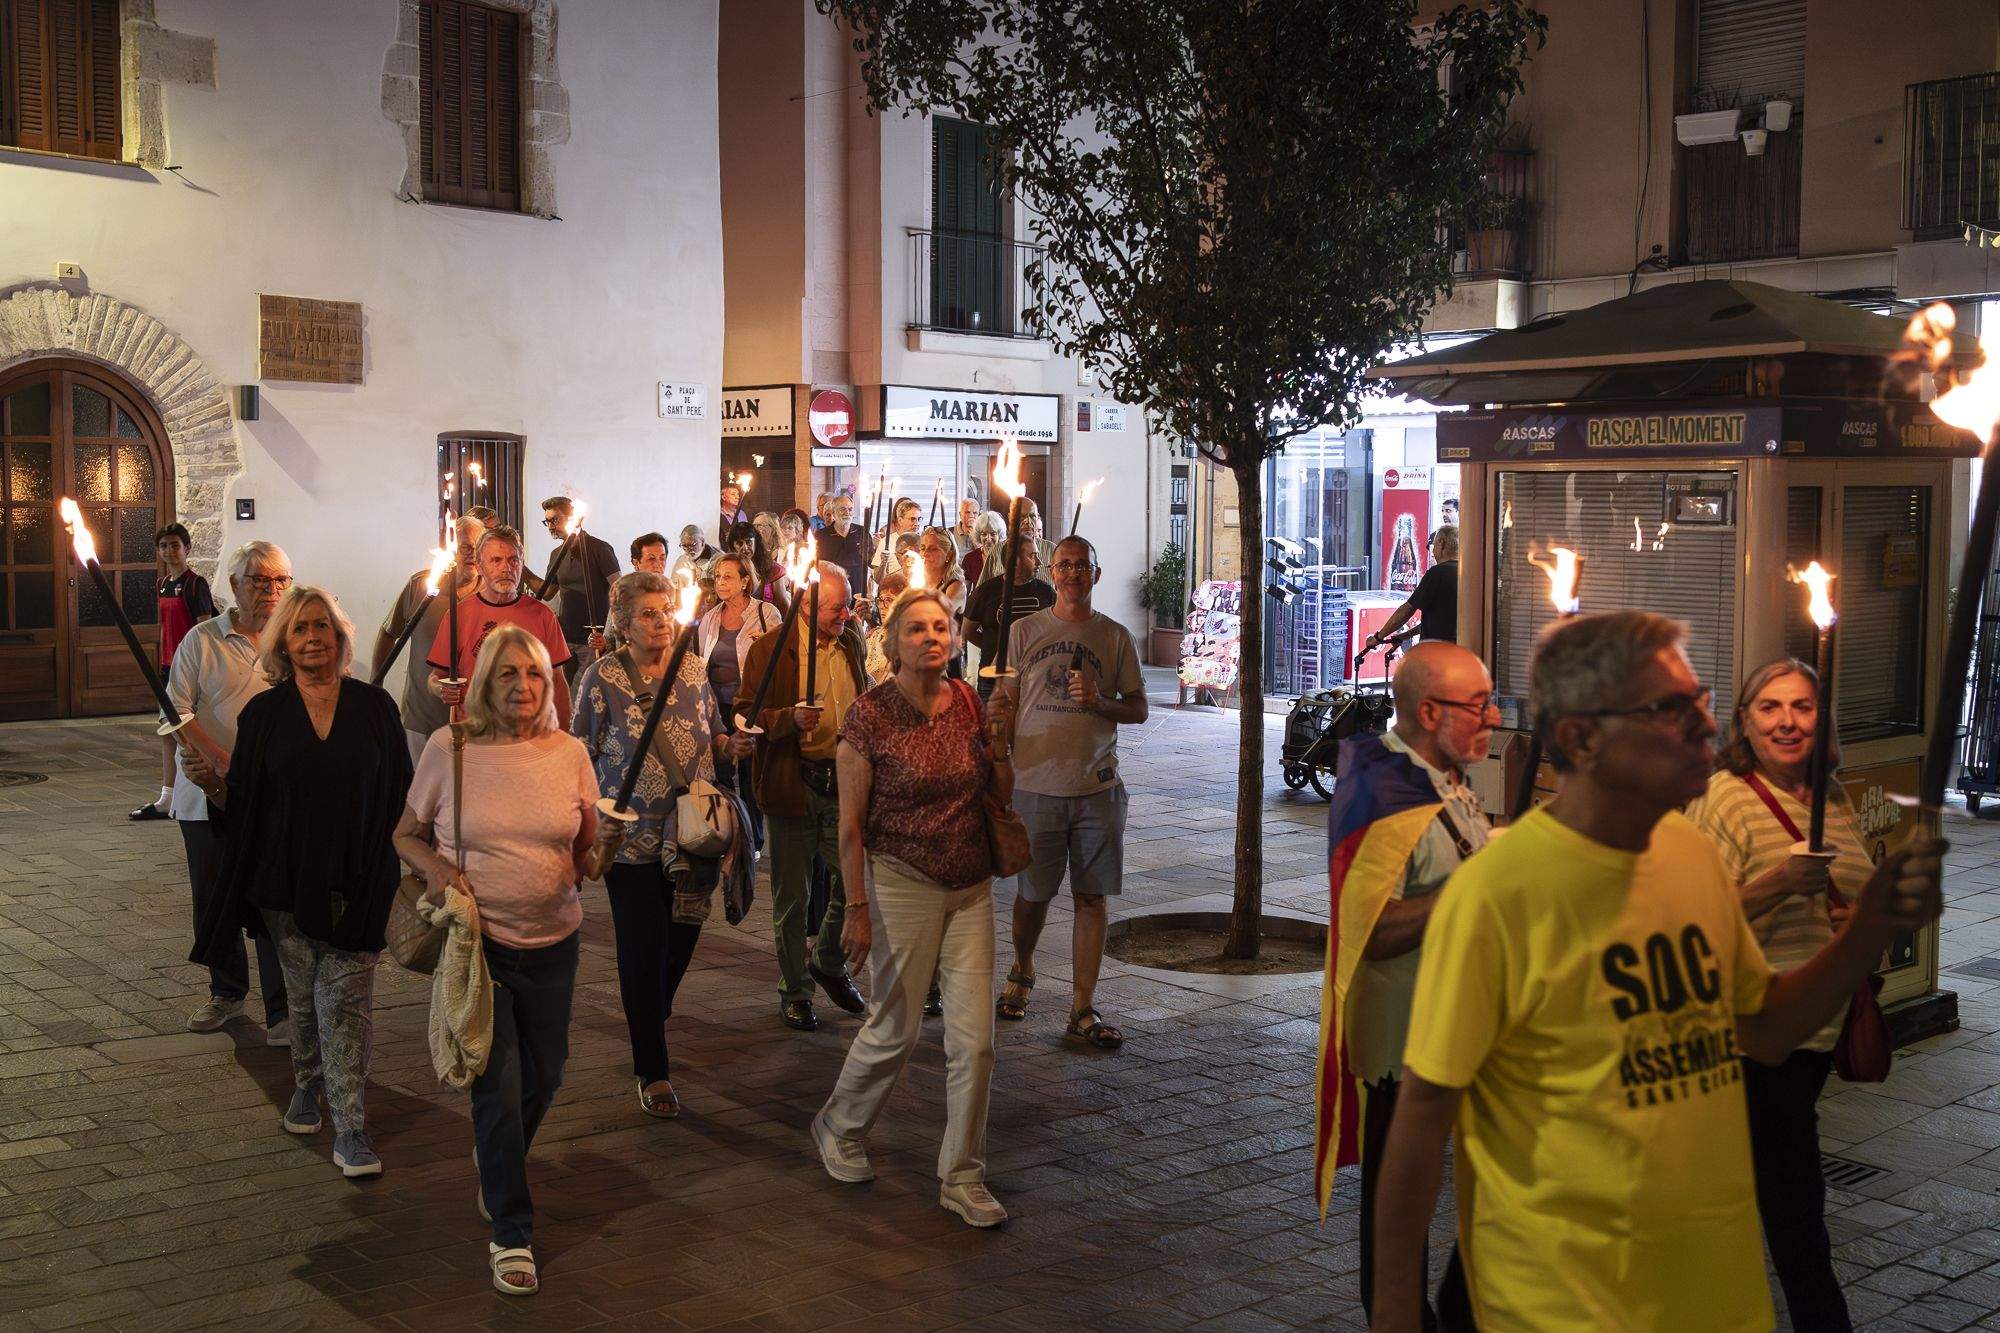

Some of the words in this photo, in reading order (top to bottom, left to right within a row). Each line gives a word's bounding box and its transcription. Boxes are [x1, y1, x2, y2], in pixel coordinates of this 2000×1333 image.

[66, 267, 73, 275] 4
[679, 387, 695, 395] PLAÇA
[684, 396, 691, 404] DE
[667, 405, 684, 415] SANT
[686, 406, 702, 416] PERE
[721, 398, 760, 420] IAN
[930, 398, 1019, 424] MARIAN
[1018, 429, 1037, 437] desde
[1037, 430, 1053, 438] 1956
[1503, 426, 1556, 441] RASCAS
[1589, 418, 1644, 446] RASCA
[1646, 417, 1667, 444] EL
[1668, 415, 1745, 443] MOMENT
[1842, 421, 1878, 436] RASCAS
[1860, 784, 1884, 814] ARA
